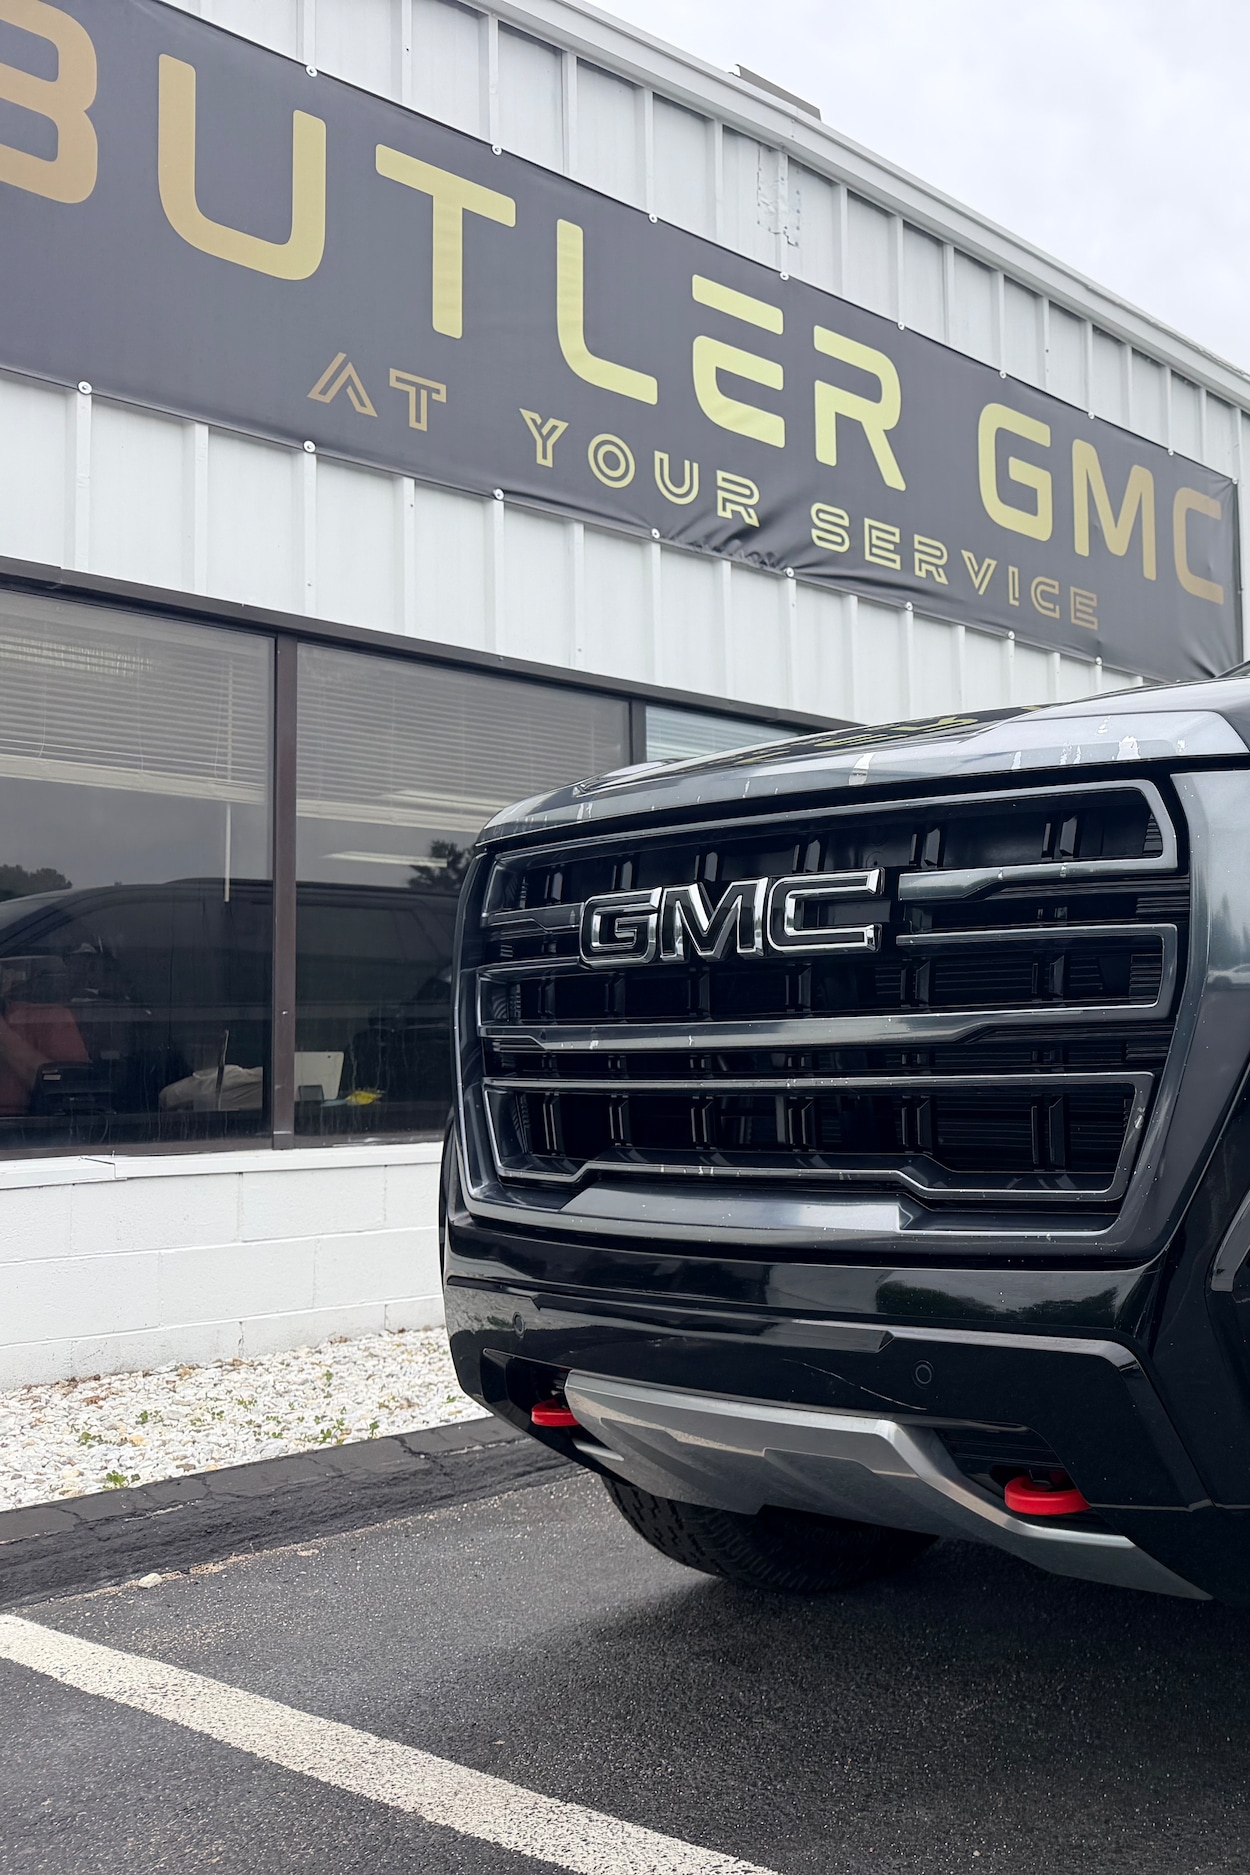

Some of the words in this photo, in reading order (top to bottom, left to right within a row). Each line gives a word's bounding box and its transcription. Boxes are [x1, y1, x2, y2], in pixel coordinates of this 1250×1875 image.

[307, 352, 447, 431] AT
[519, 408, 761, 527] YOUR
[810, 502, 1099, 630] SERVICE
[978, 402, 1225, 605] GMC
[579, 867, 886, 969] GMC
